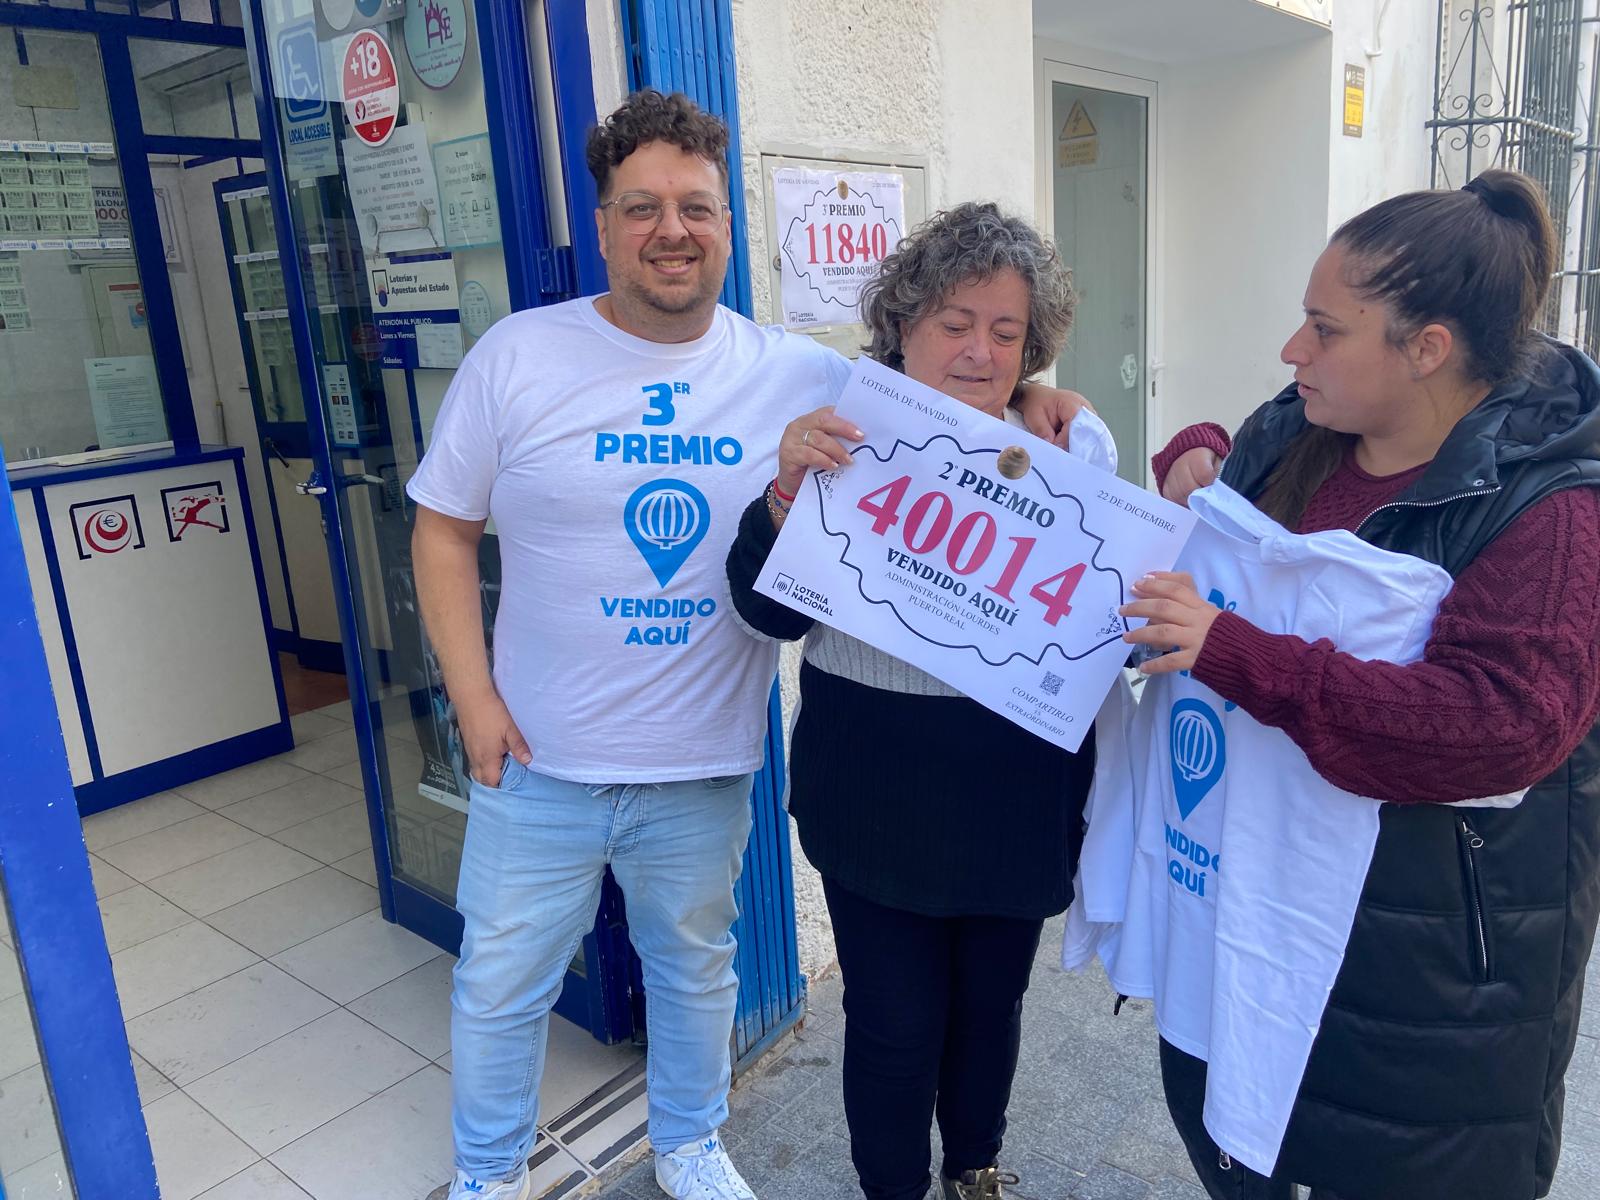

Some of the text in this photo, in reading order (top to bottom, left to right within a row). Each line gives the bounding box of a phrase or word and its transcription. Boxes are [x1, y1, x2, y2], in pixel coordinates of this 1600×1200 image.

[350, 40, 381, 80] +18
[288, 122, 331, 142] LOCAL ACCESIBLE
[829, 204, 866, 216] PREMIO
[805, 222, 886, 264] 11840
[390, 272, 412, 283] Loterías
[823, 266, 854, 276] VENDIDO
[392, 286, 417, 296] Apuestas
[429, 283, 450, 292] Estado
[861, 376, 958, 427] LOTERÍA DE NAVIDAD
[595, 433, 743, 466] PREMIO
[956, 468, 1055, 528] PREMIO
[1097, 490, 1176, 533] 22 DE DICIEMBRE
[856, 475, 1088, 627] 40014
[791, 592, 833, 616] NACIONAL
[795, 584, 828, 605] LOTERÍA
[884, 572, 1000, 635] ADMINISTRACIÓN LOURDES
[886, 548, 1020, 626] VENDIDO AQUÍ
[600, 597, 716, 618] VENDIDO
[908, 594, 965, 630] PUERTO REAL
[624, 620, 692, 646] AQUÍ
[1005, 701, 1066, 736] EXTRAORDINARIO
[1012, 686, 1074, 723] COMPARTIRLO
[1170, 860, 1206, 896] QUÍ
